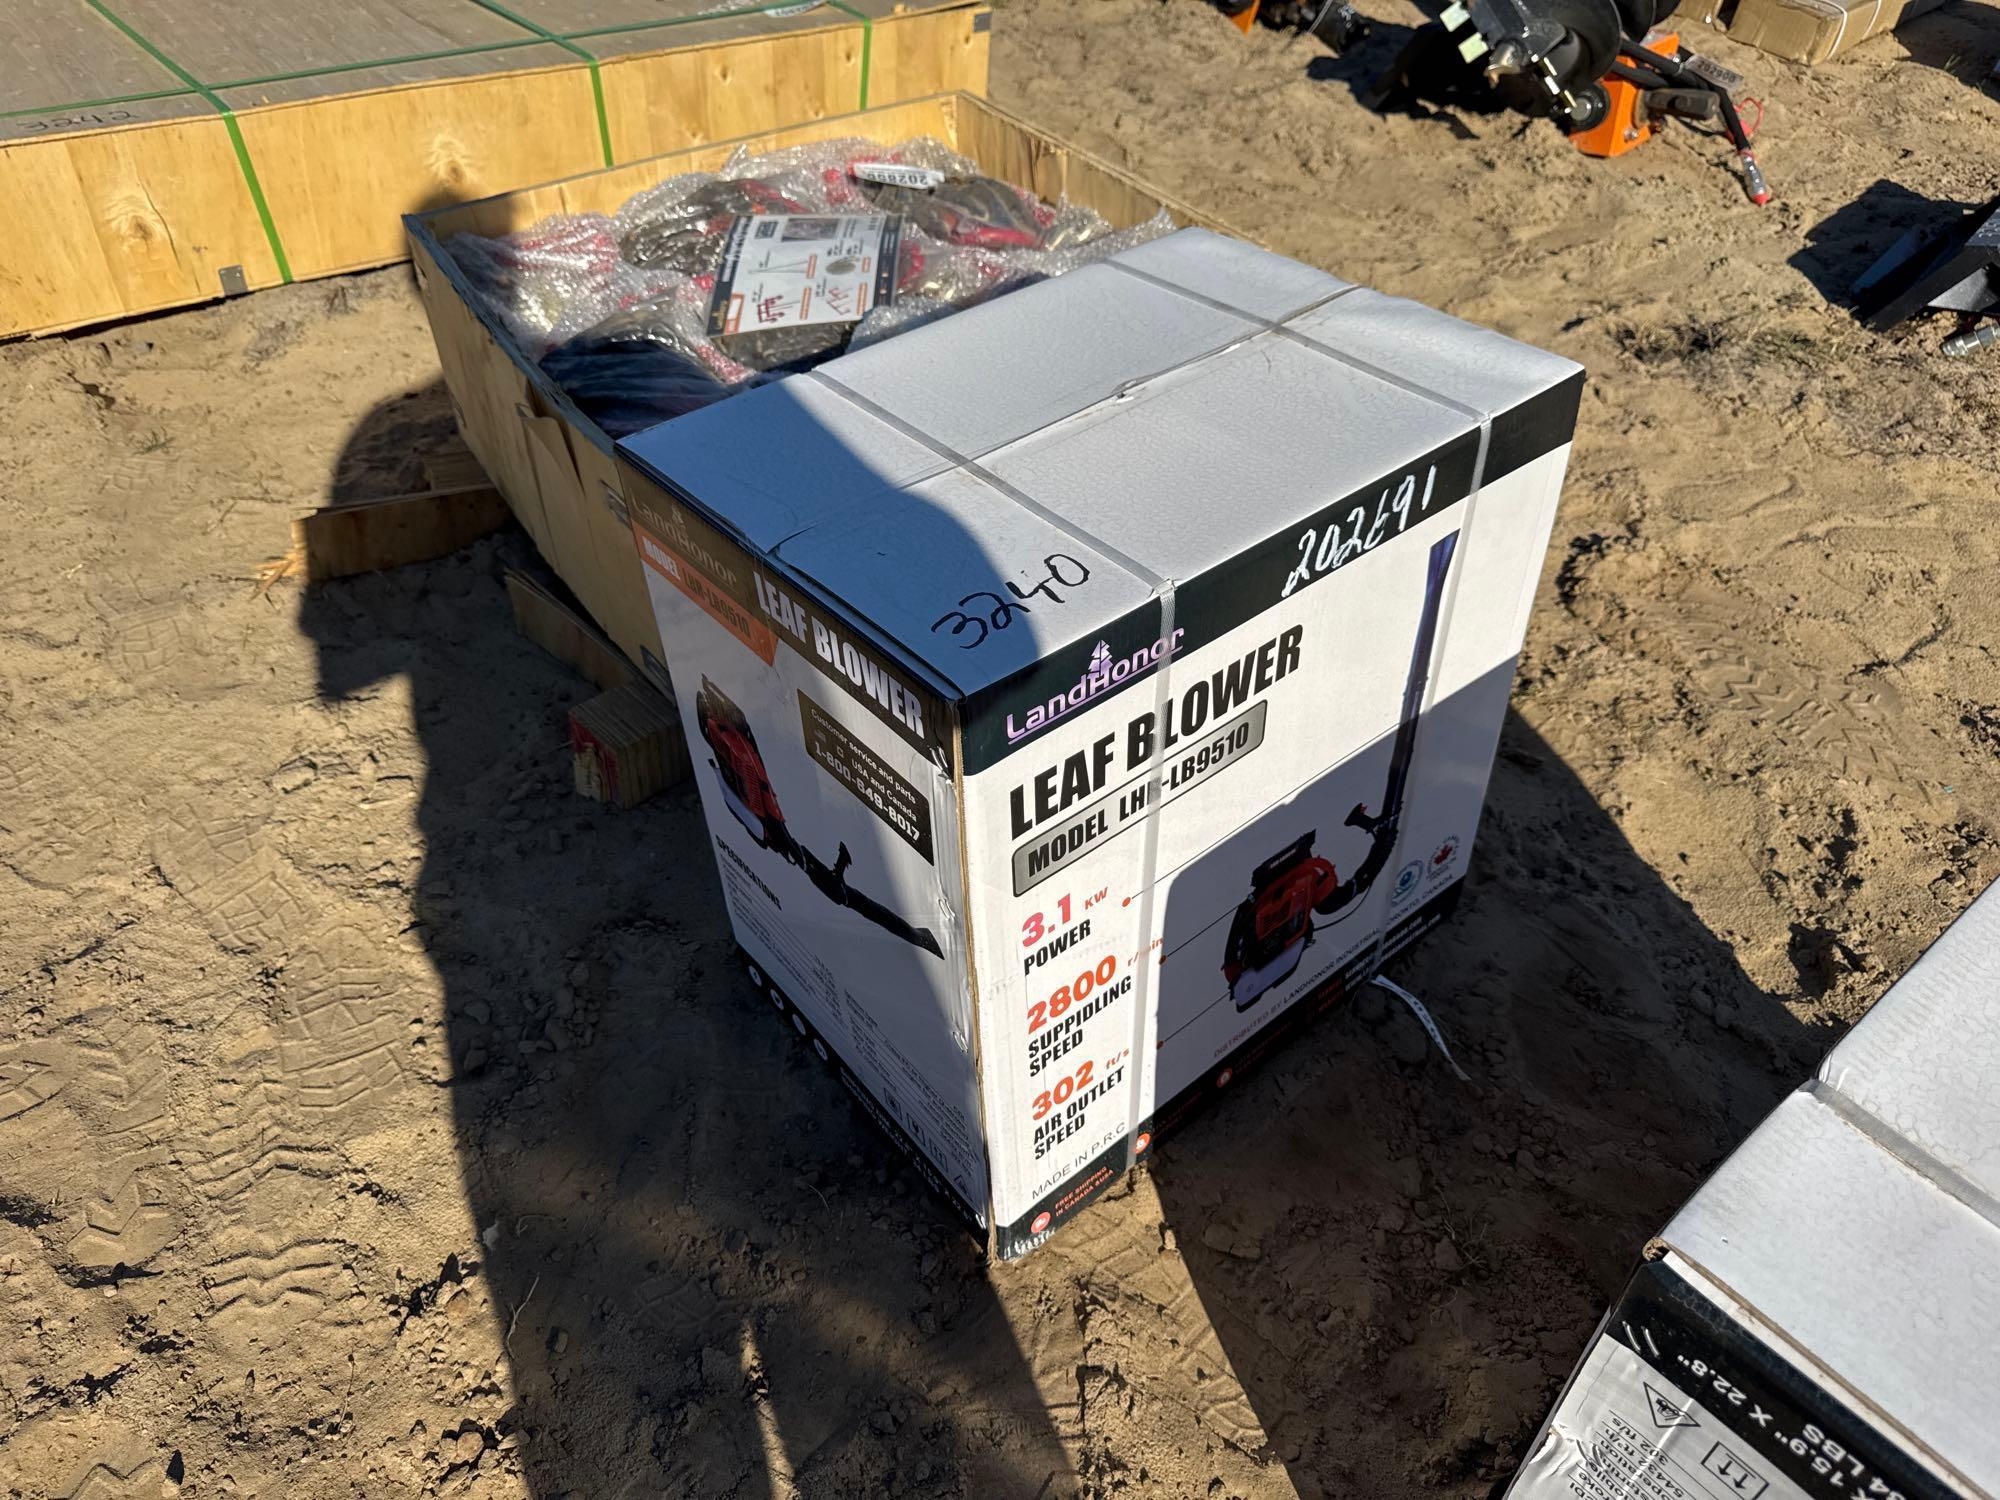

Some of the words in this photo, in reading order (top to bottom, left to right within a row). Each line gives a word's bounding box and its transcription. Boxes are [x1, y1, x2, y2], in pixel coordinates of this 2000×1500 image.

[931, 554, 1090, 649] 3240
[754, 571, 807, 643] LEAF
[812, 616, 924, 739] BLOWER
[1006, 628, 1184, 744] LandHonor
[811, 709, 848, 744] Customer
[850, 741, 877, 770] service
[878, 765, 893, 784] and
[895, 779, 916, 804] parts
[1010, 731, 1115, 841] LEAF
[1127, 624, 1303, 771] BLOWER
[851, 757, 869, 779] USA
[870, 776, 885, 793] and
[887, 789, 917, 822] Canada
[1028, 809, 1108, 877] MODEL
[1022, 893, 1070, 947] 3.1
[1024, 919, 1091, 976] POWER
[1027, 955, 1116, 1034] 2800
[1127, 937, 1165, 966] r/in
[1029, 975, 1132, 1058] SUPPIDLING
[1029, 1029, 1083, 1077] SPEED
[1032, 1060, 1094, 1120] 302
[1034, 1113, 1061, 1145] AIR
[1066, 1065, 1124, 1119] OUTLET
[1034, 1113, 1085, 1160] SPEED
[1032, 1163, 1071, 1199] MADE
[1075, 1151, 1088, 1167] IN
[1055, 1192, 1073, 1209] FREE
[1075, 1166, 1107, 1194] SHIPPING
[1064, 1186, 1094, 1210] CANADA
[1677, 1355, 1747, 1406] 22.8"
[1612, 1417, 1637, 1440] ft/s
[1749, 1404, 1773, 1428] X
[1639, 1439, 1669, 1466] 302
[1802, 1424, 1865, 1477] LBS
